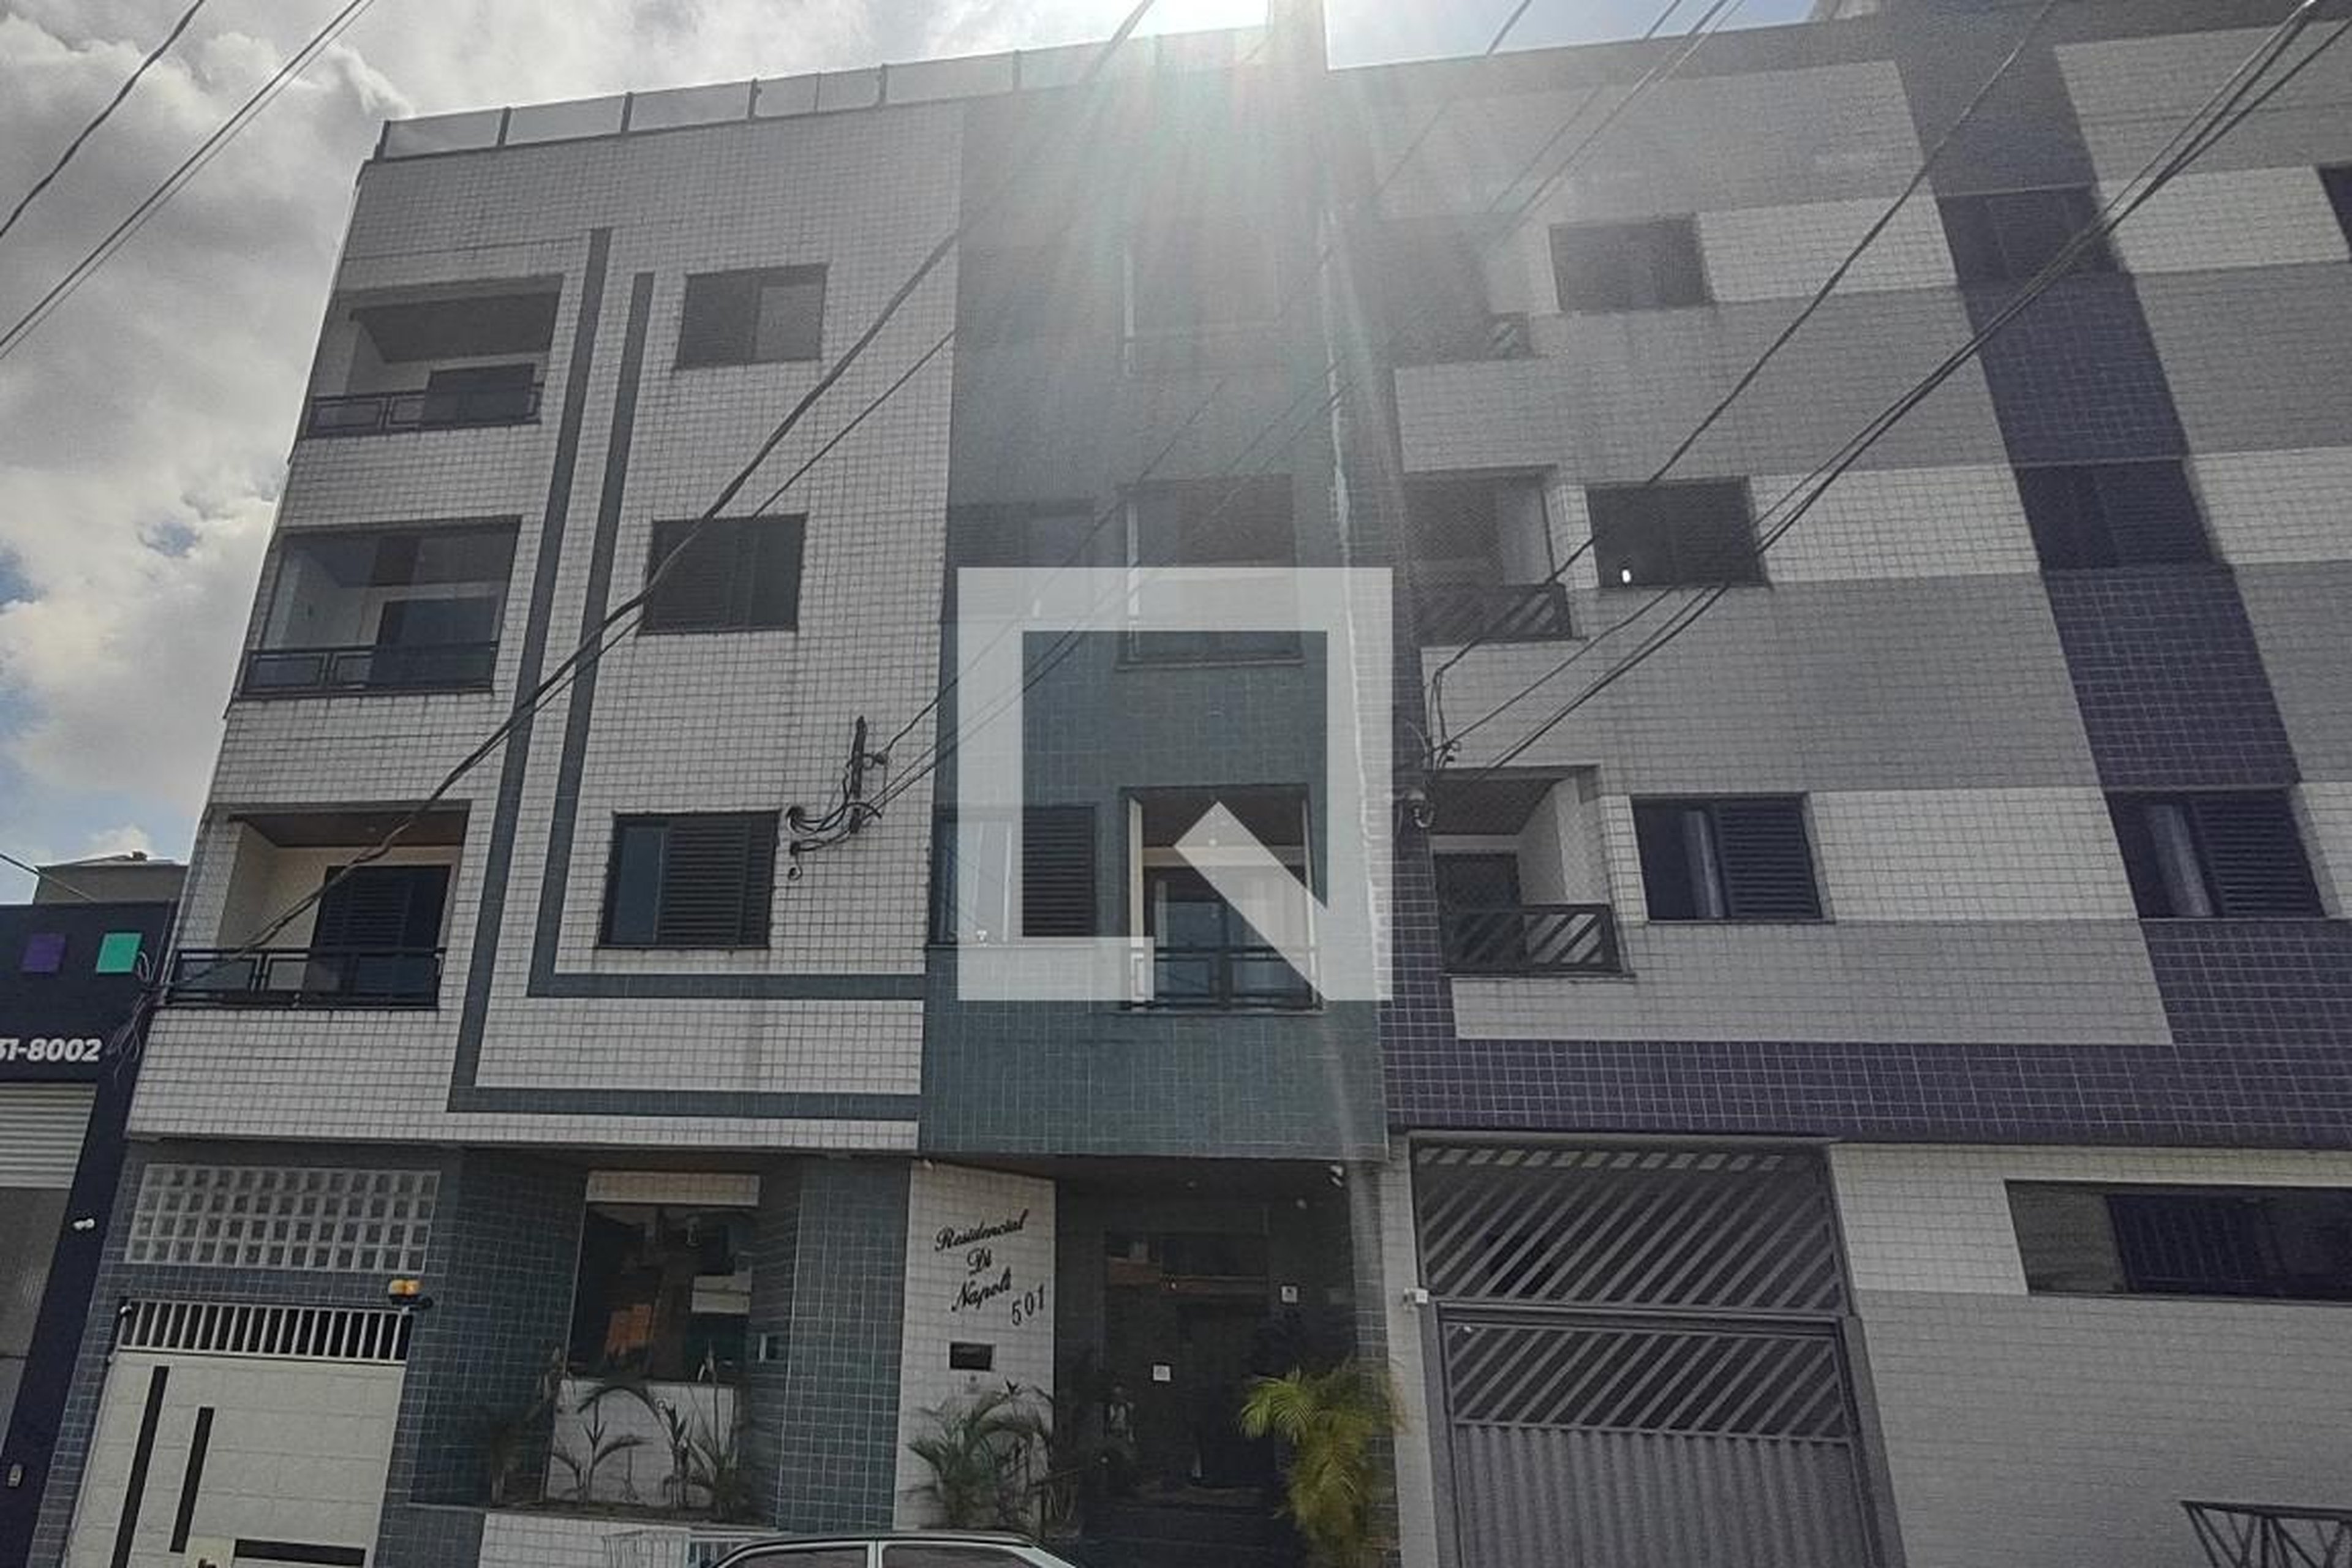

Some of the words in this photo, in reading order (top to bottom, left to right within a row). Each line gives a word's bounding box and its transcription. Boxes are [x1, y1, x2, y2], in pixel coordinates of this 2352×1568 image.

[935, 1208, 1028, 1251] Residencial
[951, 1267, 1011, 1311] Napoli
[1011, 1284, 1044, 1326] 501
